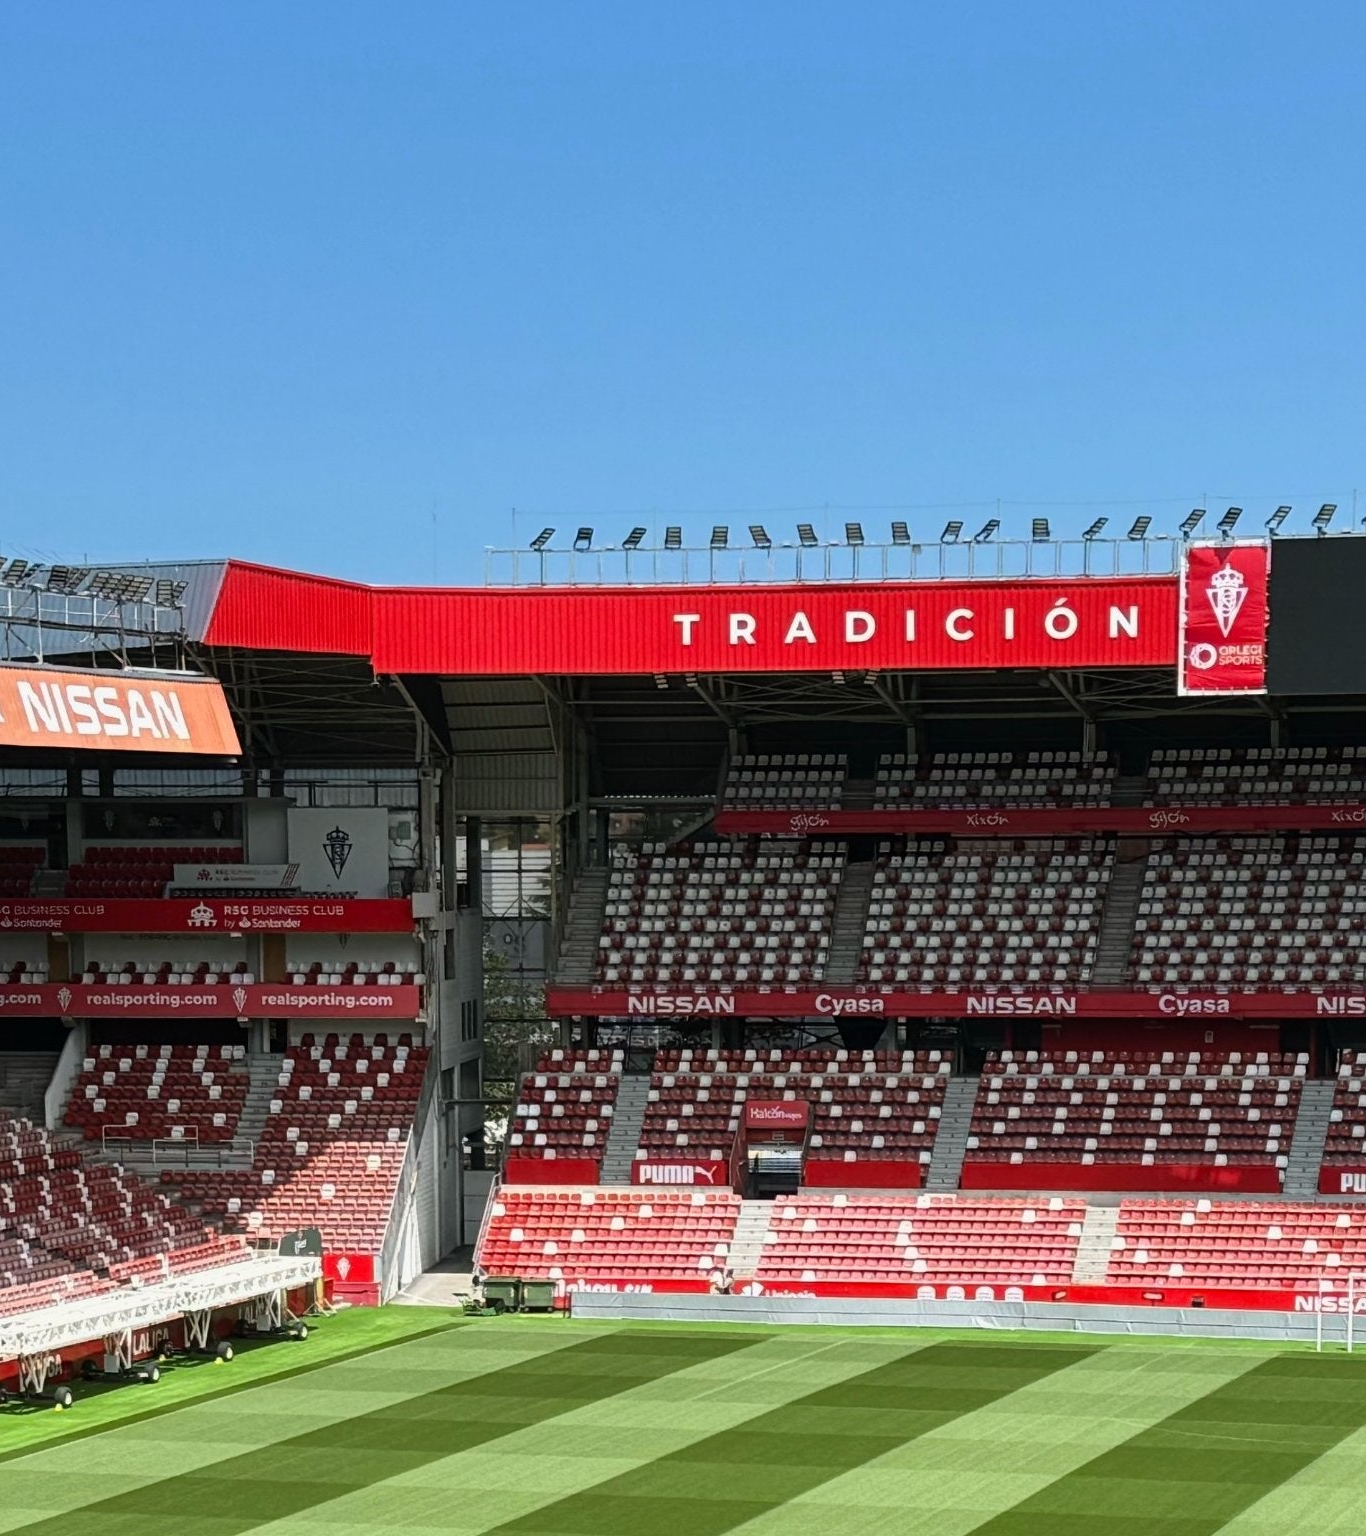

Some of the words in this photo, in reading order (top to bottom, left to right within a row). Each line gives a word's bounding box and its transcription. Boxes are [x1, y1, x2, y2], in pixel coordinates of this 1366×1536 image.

[673, 597, 1138, 645] TRADICIÓN
[1219, 656, 1263, 666] SPORTS
[18, 681, 191, 739] NISSAN
[14, 905, 70, 915] BUSINESS
[74, 905, 105, 915] CLUB
[253, 906, 309, 915] BUSINESS
[313, 906, 344, 915] CLUB
[86, 991, 218, 1008] realsporting.com
[261, 992, 393, 1008] realsporting.com
[628, 996, 735, 1013] NISSAN
[815, 994, 884, 1016] Cyasa
[967, 996, 1076, 1014] NISSAN
[1158, 994, 1230, 1016] Cyasa
[639, 1165, 694, 1184] PUMA
